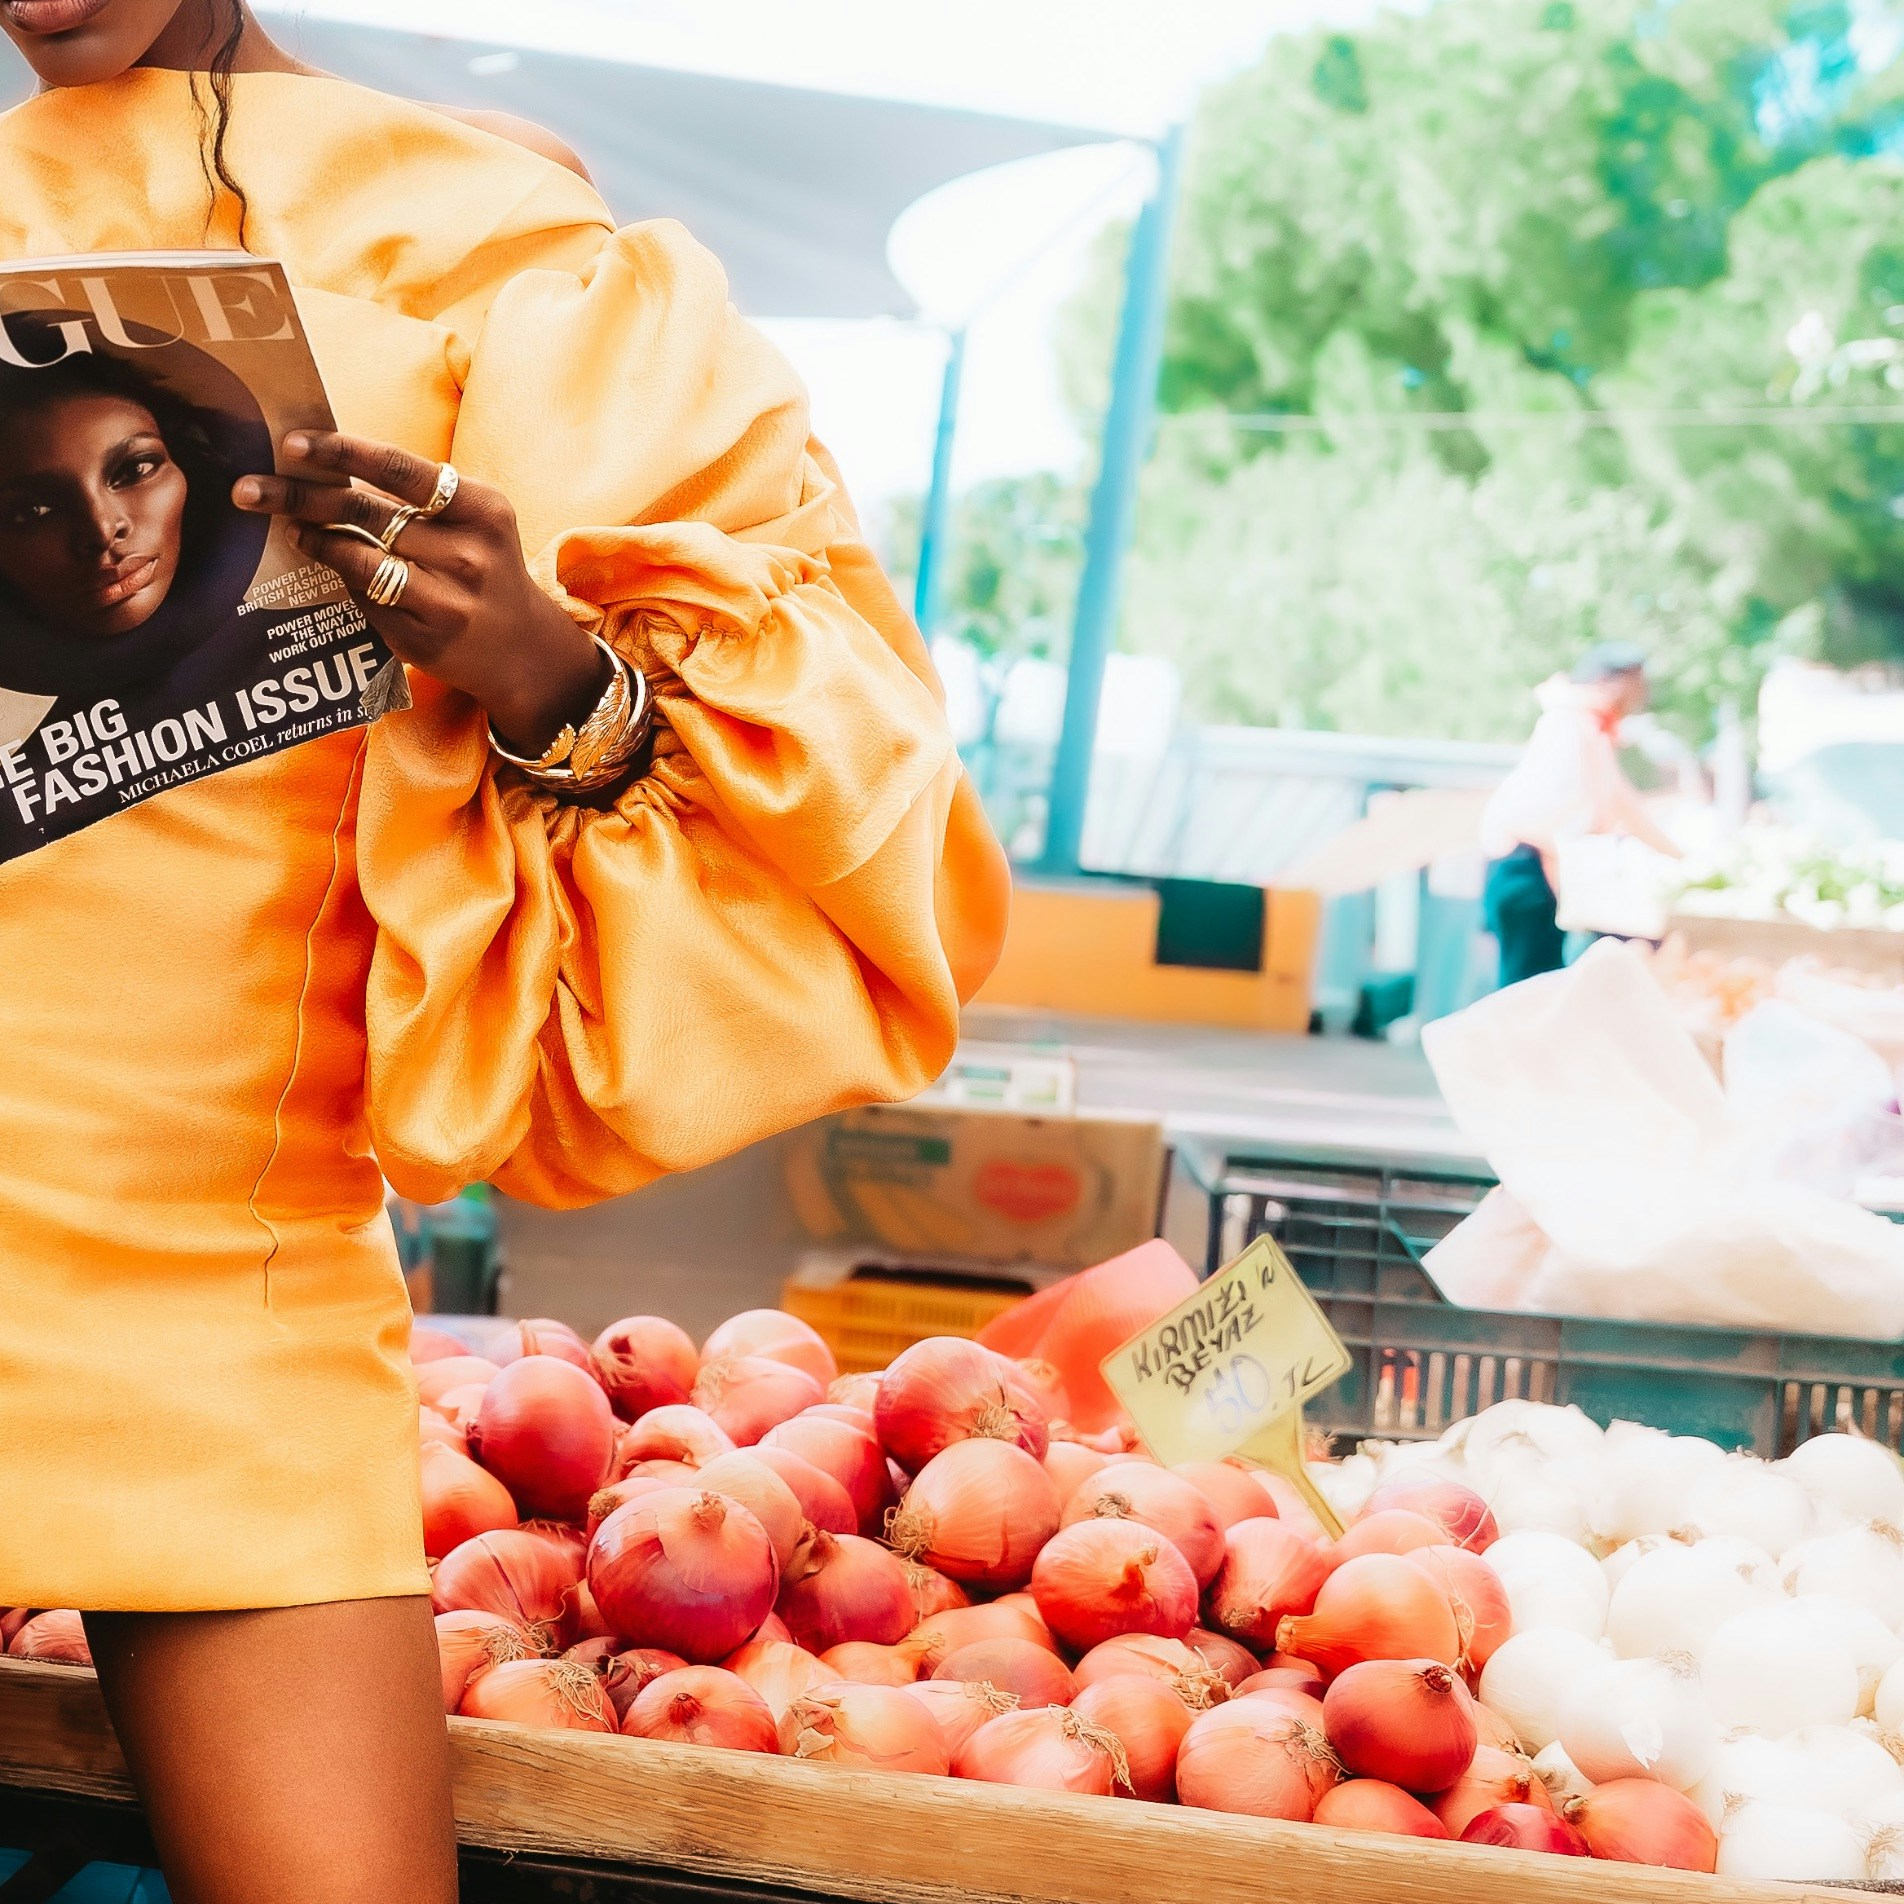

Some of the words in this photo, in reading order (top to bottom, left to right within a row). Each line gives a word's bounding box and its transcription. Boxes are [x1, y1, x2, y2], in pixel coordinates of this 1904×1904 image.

[252, 571, 297, 598] POWER
[299, 561, 330, 581] PLA
[288, 588, 319, 607] NEW
[237, 588, 286, 616] BRITISH
[267, 614, 312, 639] POWER
[314, 598, 357, 622] MOVES
[269, 641, 308, 664] WORK
[310, 631, 334, 648] OUT
[337, 618, 367, 639] NOW
[291, 626, 315, 642] THE
[316, 616, 344, 633] WAY
[11, 701, 229, 825] FASHION
[235, 642, 380, 731] ISSUE
[39, 698, 128, 764] BIG
[119, 755, 221, 804] MICHAELA
[222, 734, 274, 767] COEL
[277, 714, 333, 744] returns
[336, 707, 353, 724] in
[1165, 1303, 1265, 1395] BEYAZ
